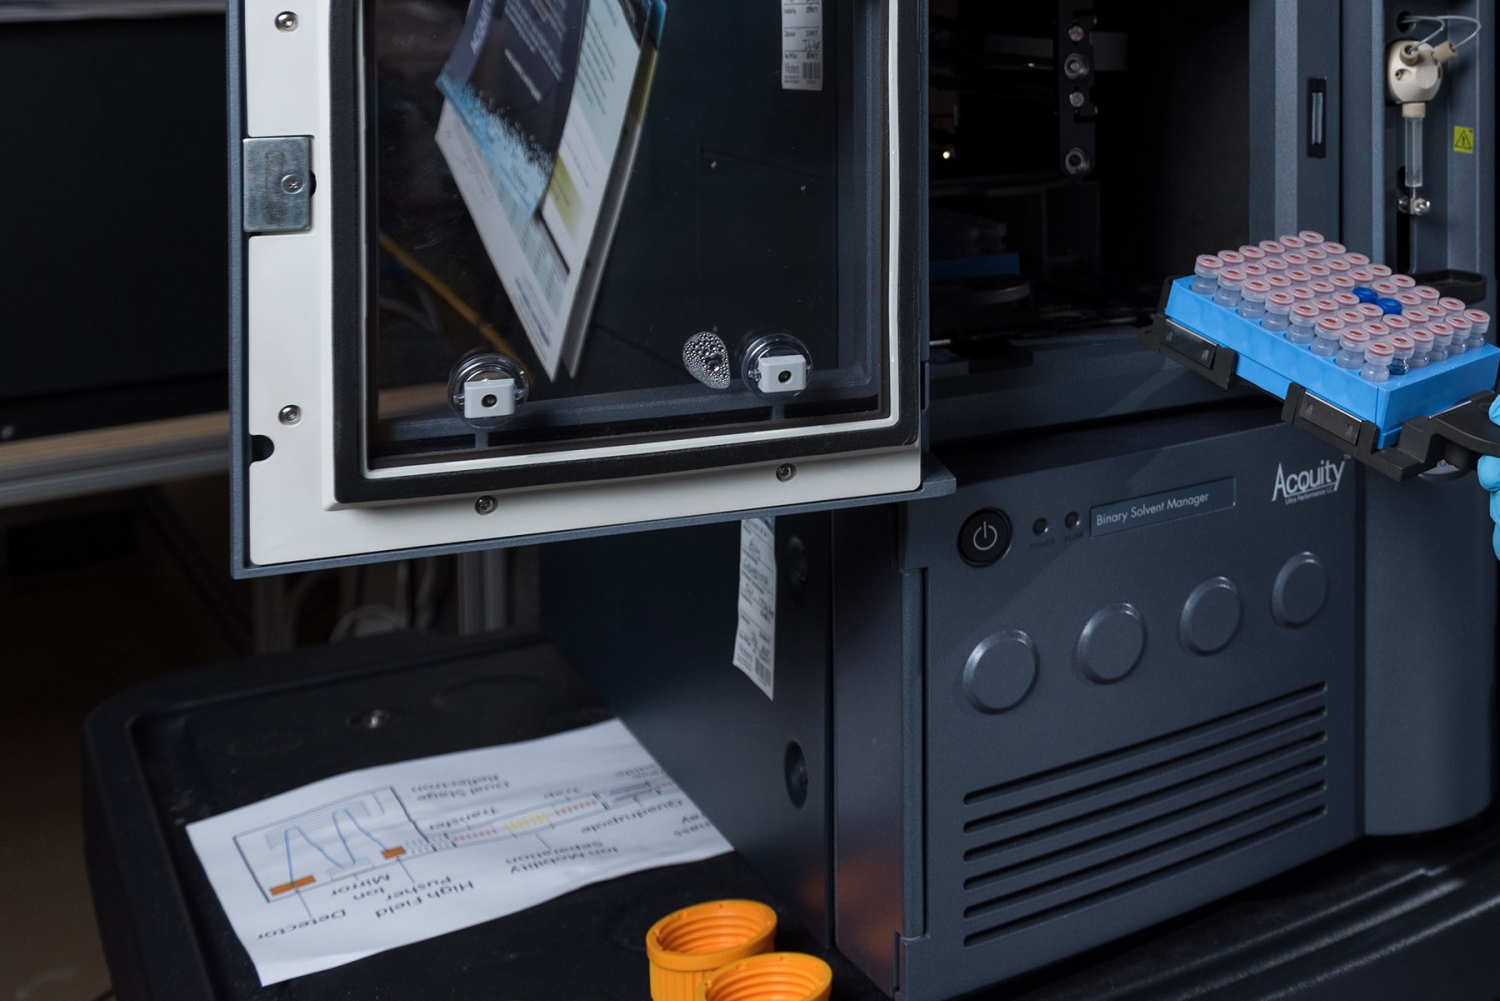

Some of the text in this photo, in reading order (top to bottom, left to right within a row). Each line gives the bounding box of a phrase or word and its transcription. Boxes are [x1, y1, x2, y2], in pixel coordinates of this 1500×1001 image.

[1096, 492, 1210, 527] Binary Solvent Manager
[331, 871, 390, 897] Mirror
[352, 885, 385, 901] Ion
[374, 879, 474, 919] High Field
[386, 875, 452, 901] Pusher
[256, 907, 347, 941] Detector
